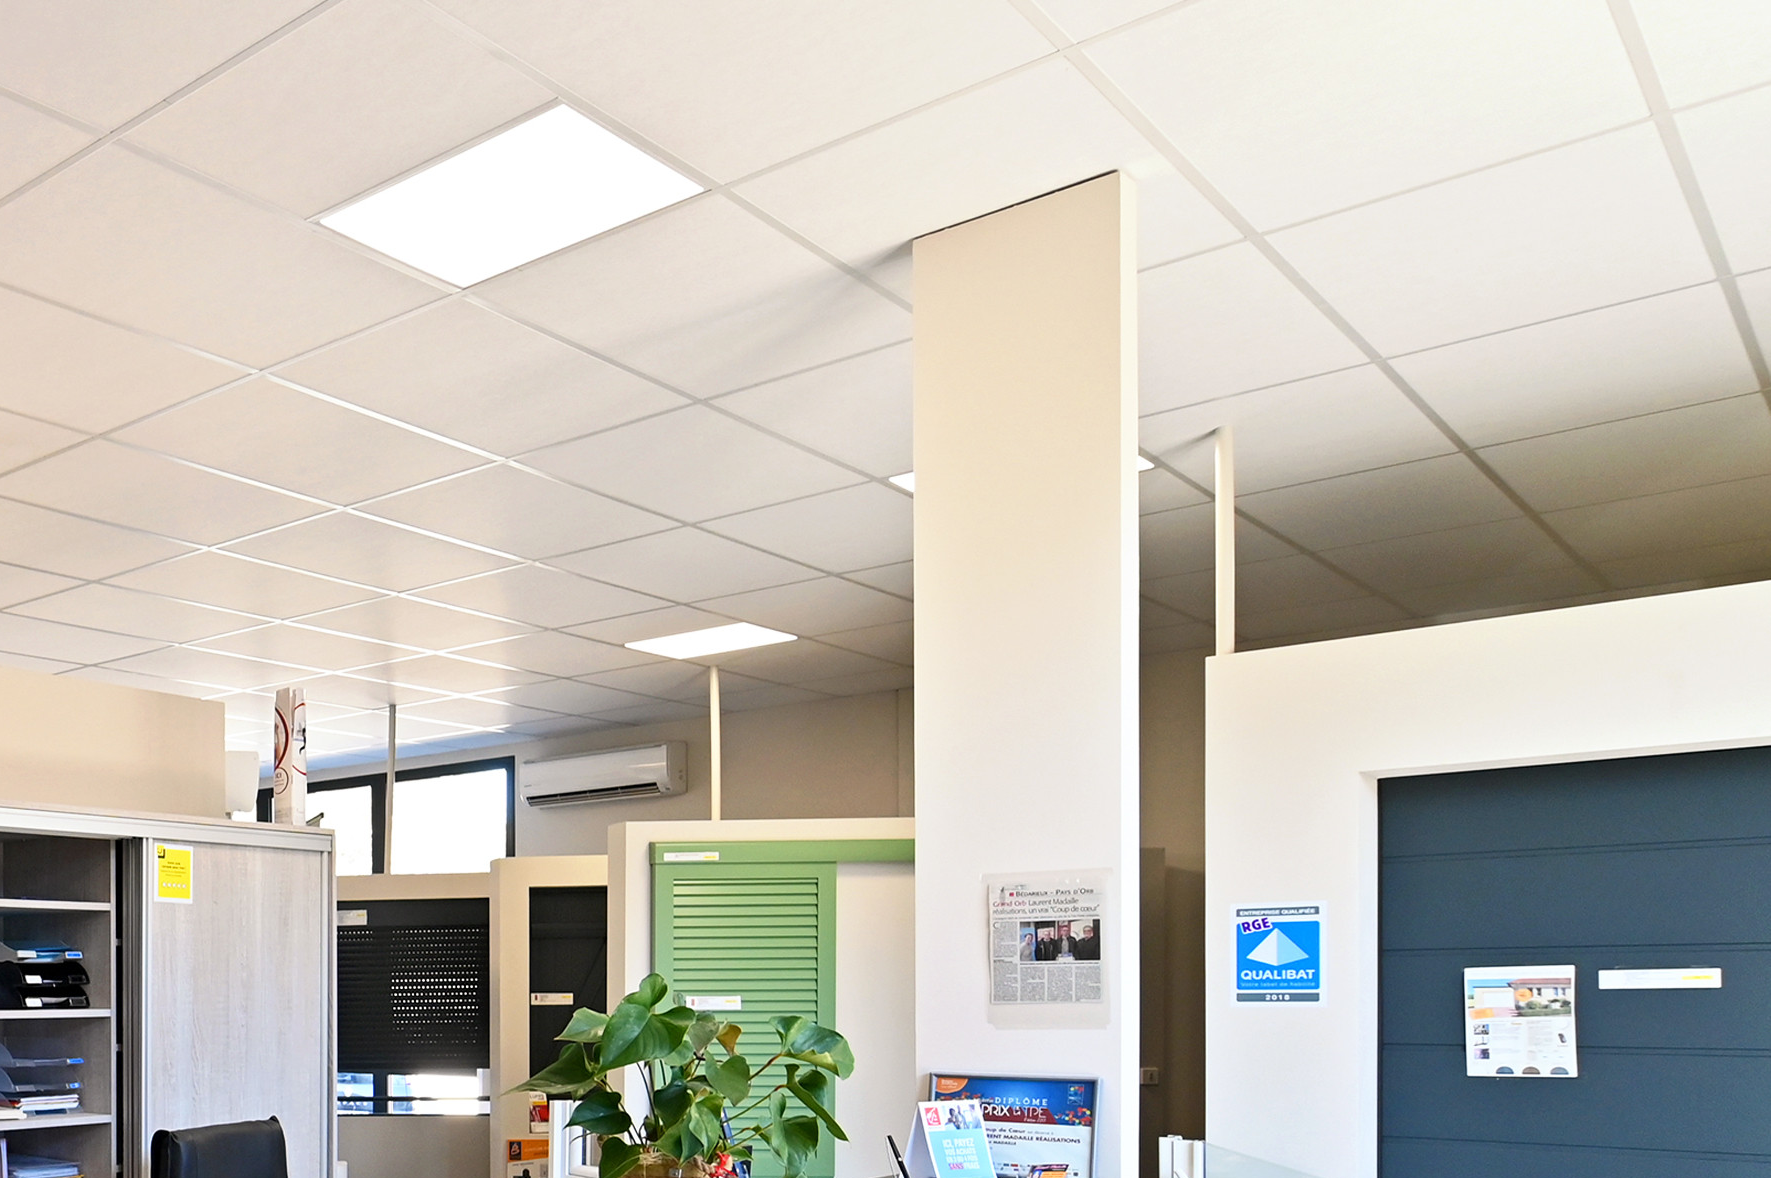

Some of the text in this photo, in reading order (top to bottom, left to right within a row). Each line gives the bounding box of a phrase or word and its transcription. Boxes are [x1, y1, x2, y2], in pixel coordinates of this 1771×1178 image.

[1241, 917, 1271, 933] RGE
[1240, 969, 1316, 980] QUALIBAT
[994, 1096, 1048, 1106] DIPLÔME
[981, 1103, 1010, 1117] PRIX
